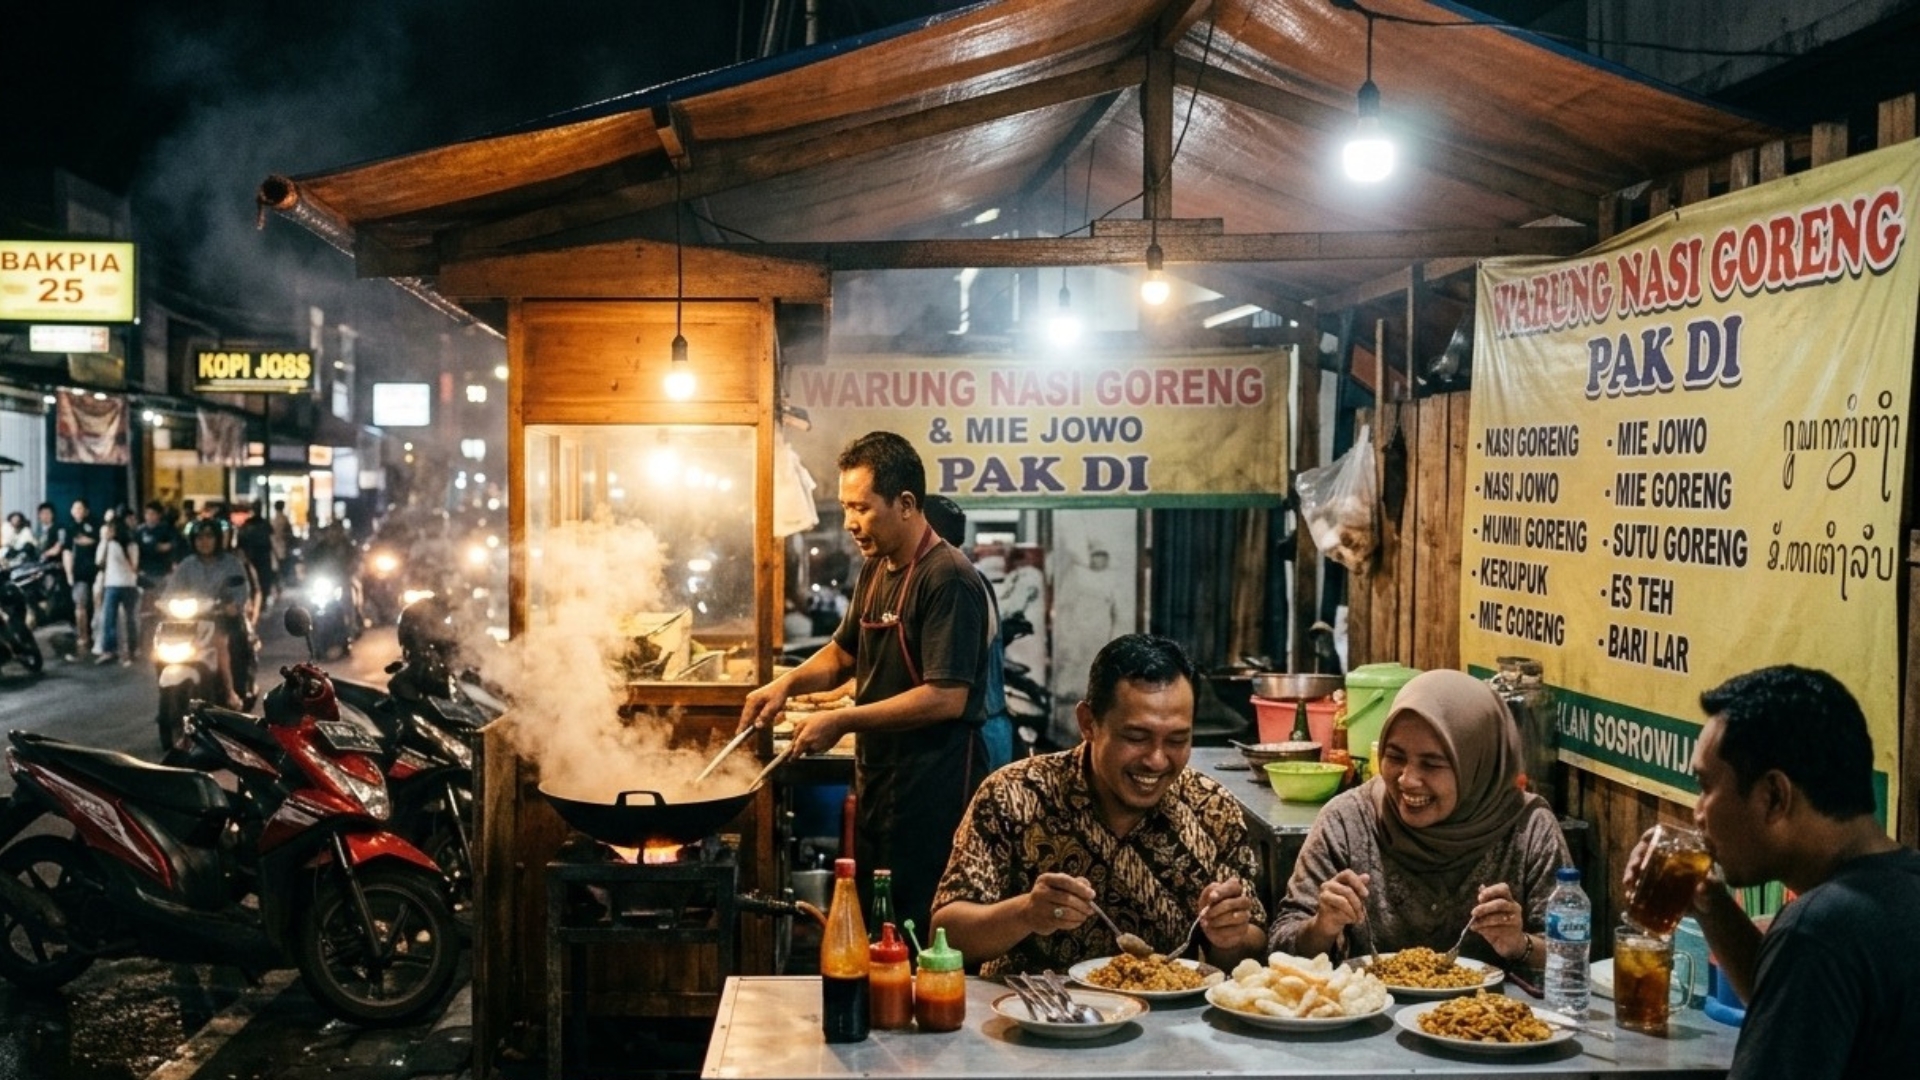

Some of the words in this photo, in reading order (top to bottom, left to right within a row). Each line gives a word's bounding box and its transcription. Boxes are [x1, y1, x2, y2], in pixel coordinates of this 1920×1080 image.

[1, 252, 120, 272] BAKPIA
[1494, 261, 1612, 334] WARUNG
[1617, 238, 1702, 313] NASI
[1711, 191, 1901, 296] GORENG
[38, 278, 84, 303] 25
[199, 353, 250, 378] KOPI
[1586, 326, 1673, 393] PAK
[1687, 315, 1742, 387] DI
[800, 370, 975, 408] WARUNG
[991, 370, 1080, 407] NASI
[1097, 367, 1263, 406] GORENG
[929, 417, 953, 443] &
[966, 417, 1028, 443] MIE
[1040, 416, 1143, 443] JOWO
[1485, 427, 1514, 457] NASI
[1517, 425, 1579, 457] GORENG
[1617, 421, 1648, 455] MIE
[1653, 417, 1707, 454] JOWO
[937, 456, 1065, 493] PAK
[1081, 456, 1149, 491] DI
[1483, 471, 1514, 502] NASI
[1516, 472, 1559, 503] JOWO
[1615, 472, 1647, 506] MIE
[1651, 471, 1732, 509] GORENG
[1525, 517, 1587, 552] GORENG
[1613, 523, 1659, 559] SUTU
[1664, 526, 1748, 568] GORENG
[1480, 557, 1548, 595] KERUPUK
[1611, 573, 1632, 609] ES
[1638, 577, 1673, 615] TEH
[1479, 601, 1502, 632] MIE
[1506, 605, 1564, 645] GORENG
[1608, 624, 1647, 664] BARI
[1653, 631, 1688, 673] LAR
